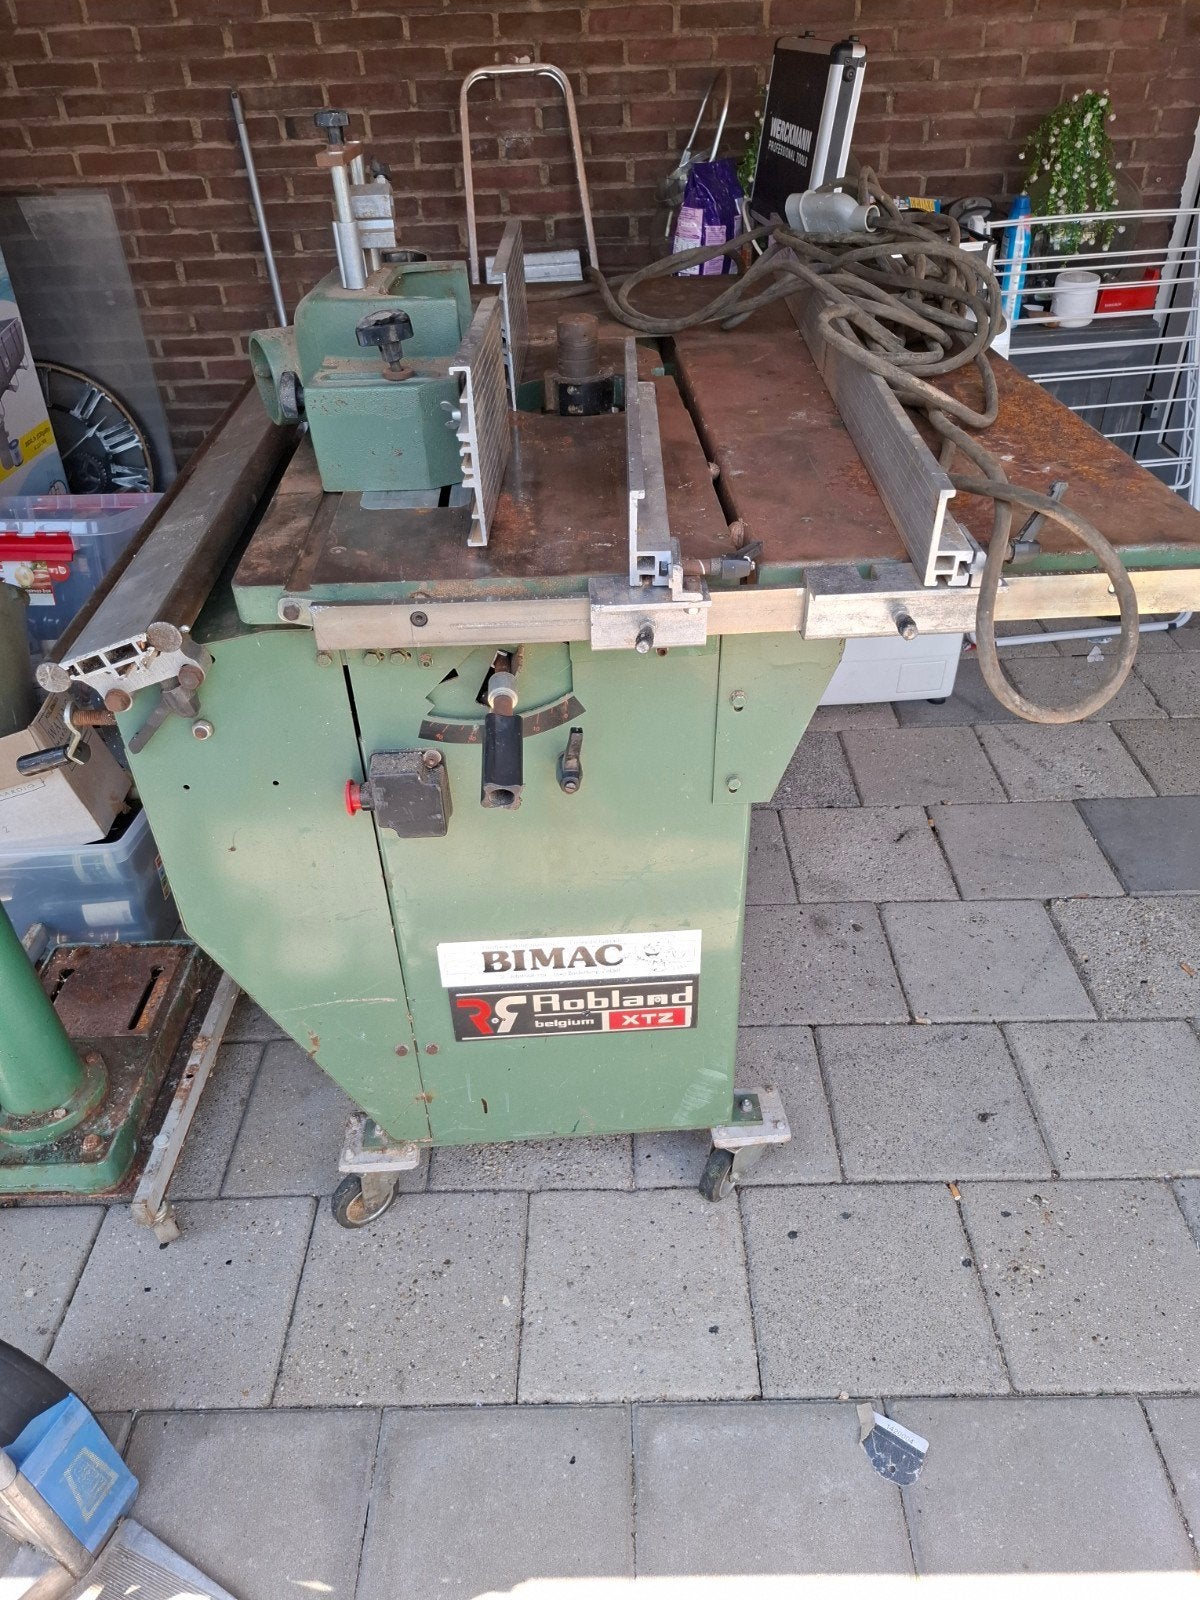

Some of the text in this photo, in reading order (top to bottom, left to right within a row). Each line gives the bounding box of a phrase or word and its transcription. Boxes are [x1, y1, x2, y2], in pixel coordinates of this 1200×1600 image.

[770, 117, 812, 152] WERCKMANN
[768, 140, 808, 168] PROFESSIONAL TOOLS
[482, 944, 624, 973] BIMAC
[533, 985, 693, 1012] Robland
[534, 1012, 674, 1029] belgium XTZ
